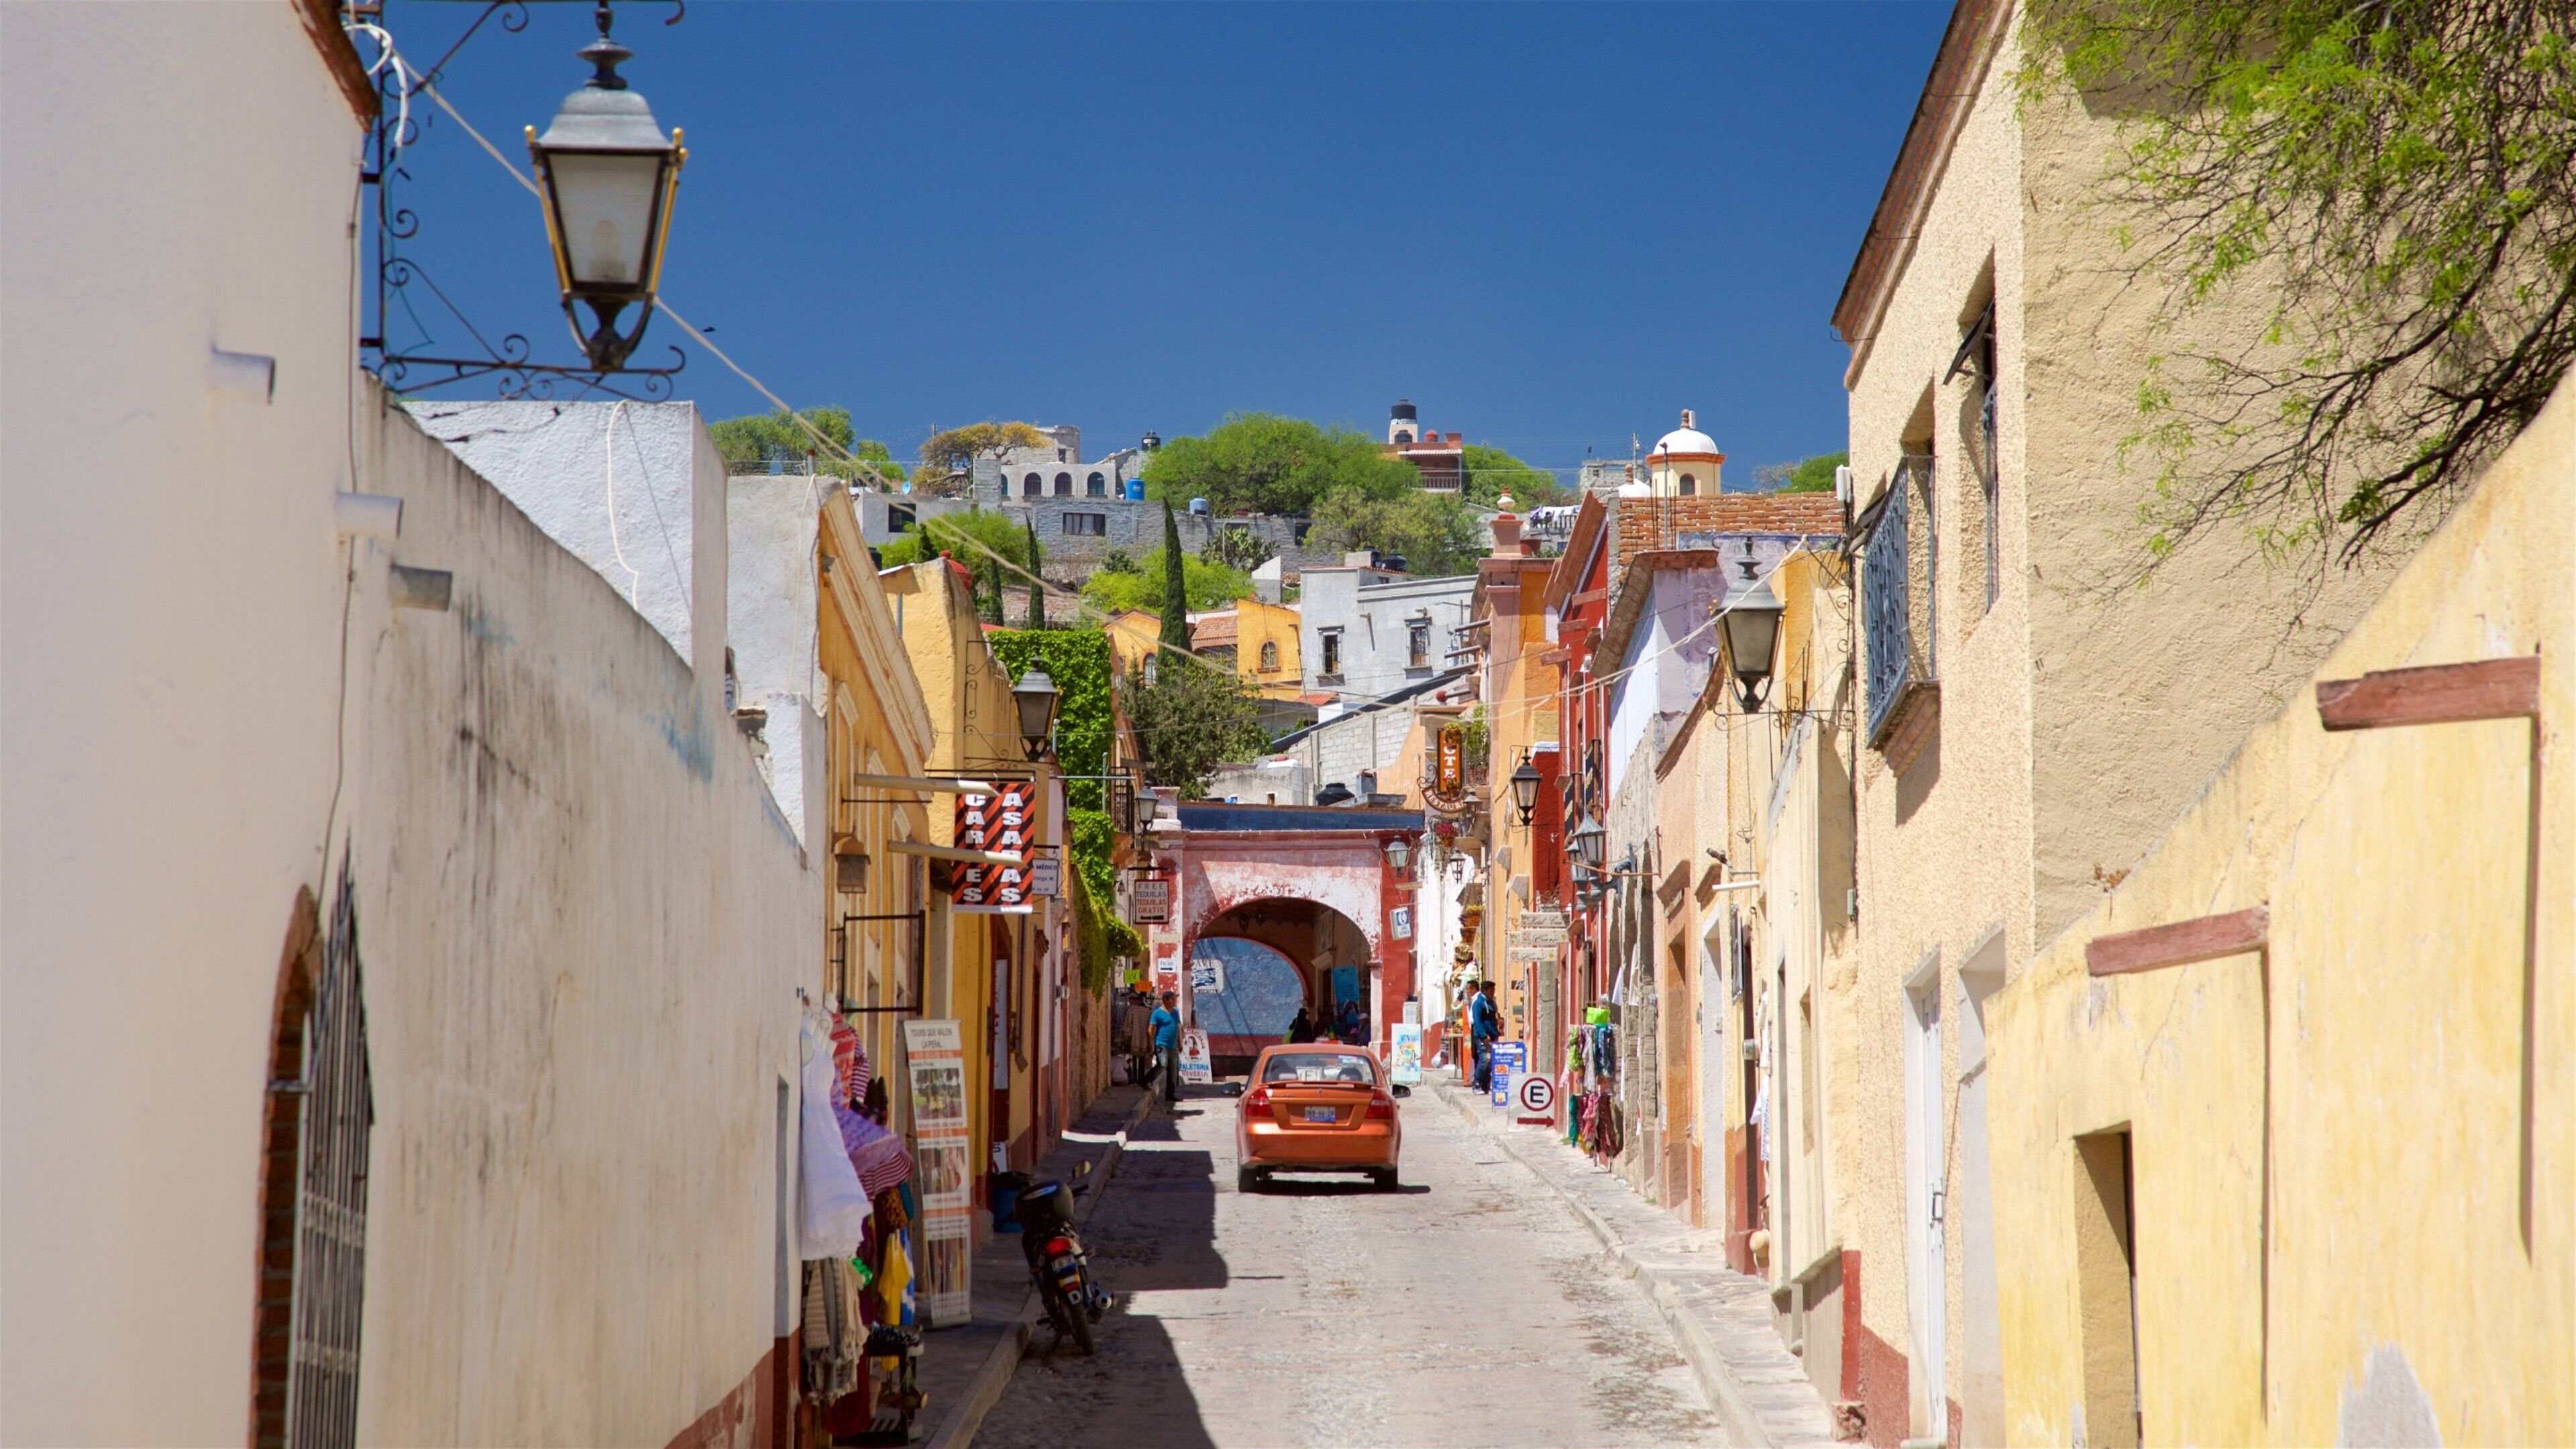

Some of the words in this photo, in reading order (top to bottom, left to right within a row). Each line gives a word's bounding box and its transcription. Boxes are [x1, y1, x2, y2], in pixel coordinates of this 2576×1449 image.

[1426, 790, 1467, 810] RESTAURA
[963, 793, 986, 902] CARES
[1138, 882, 1164, 890] FREE
[1530, 1085, 1544, 1104] E
